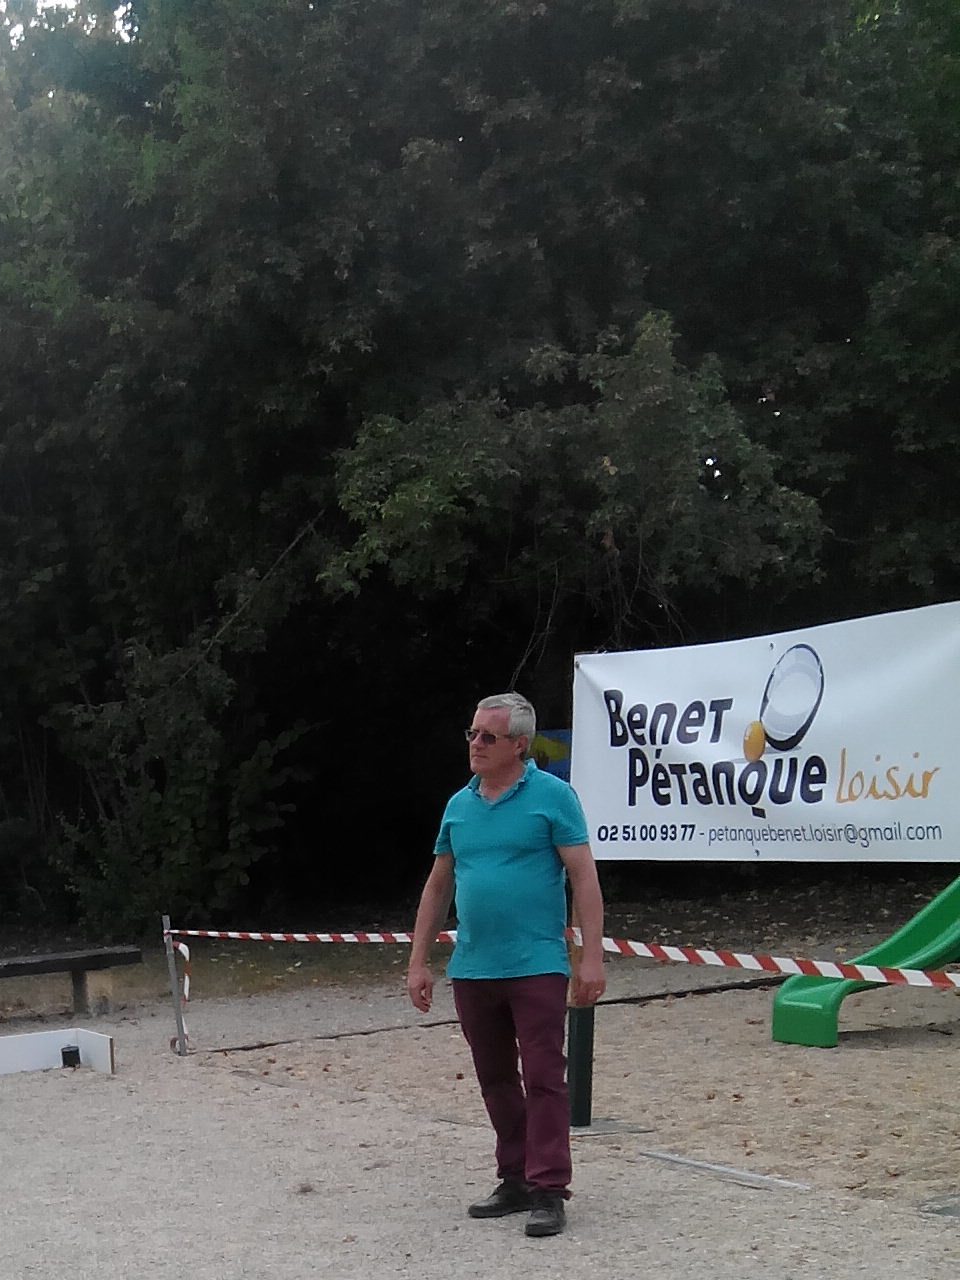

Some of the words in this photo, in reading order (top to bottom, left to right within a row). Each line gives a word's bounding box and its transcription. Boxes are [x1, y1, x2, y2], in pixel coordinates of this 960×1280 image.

[597, 825, 619, 842] 02
[622, 825, 637, 842] 51
[639, 824, 657, 842] 00
[660, 824, 678, 842] 93
[680, 824, 696, 842] 77
[708, 822, 943, 848] petanquebenet.loisir@gmail.com
